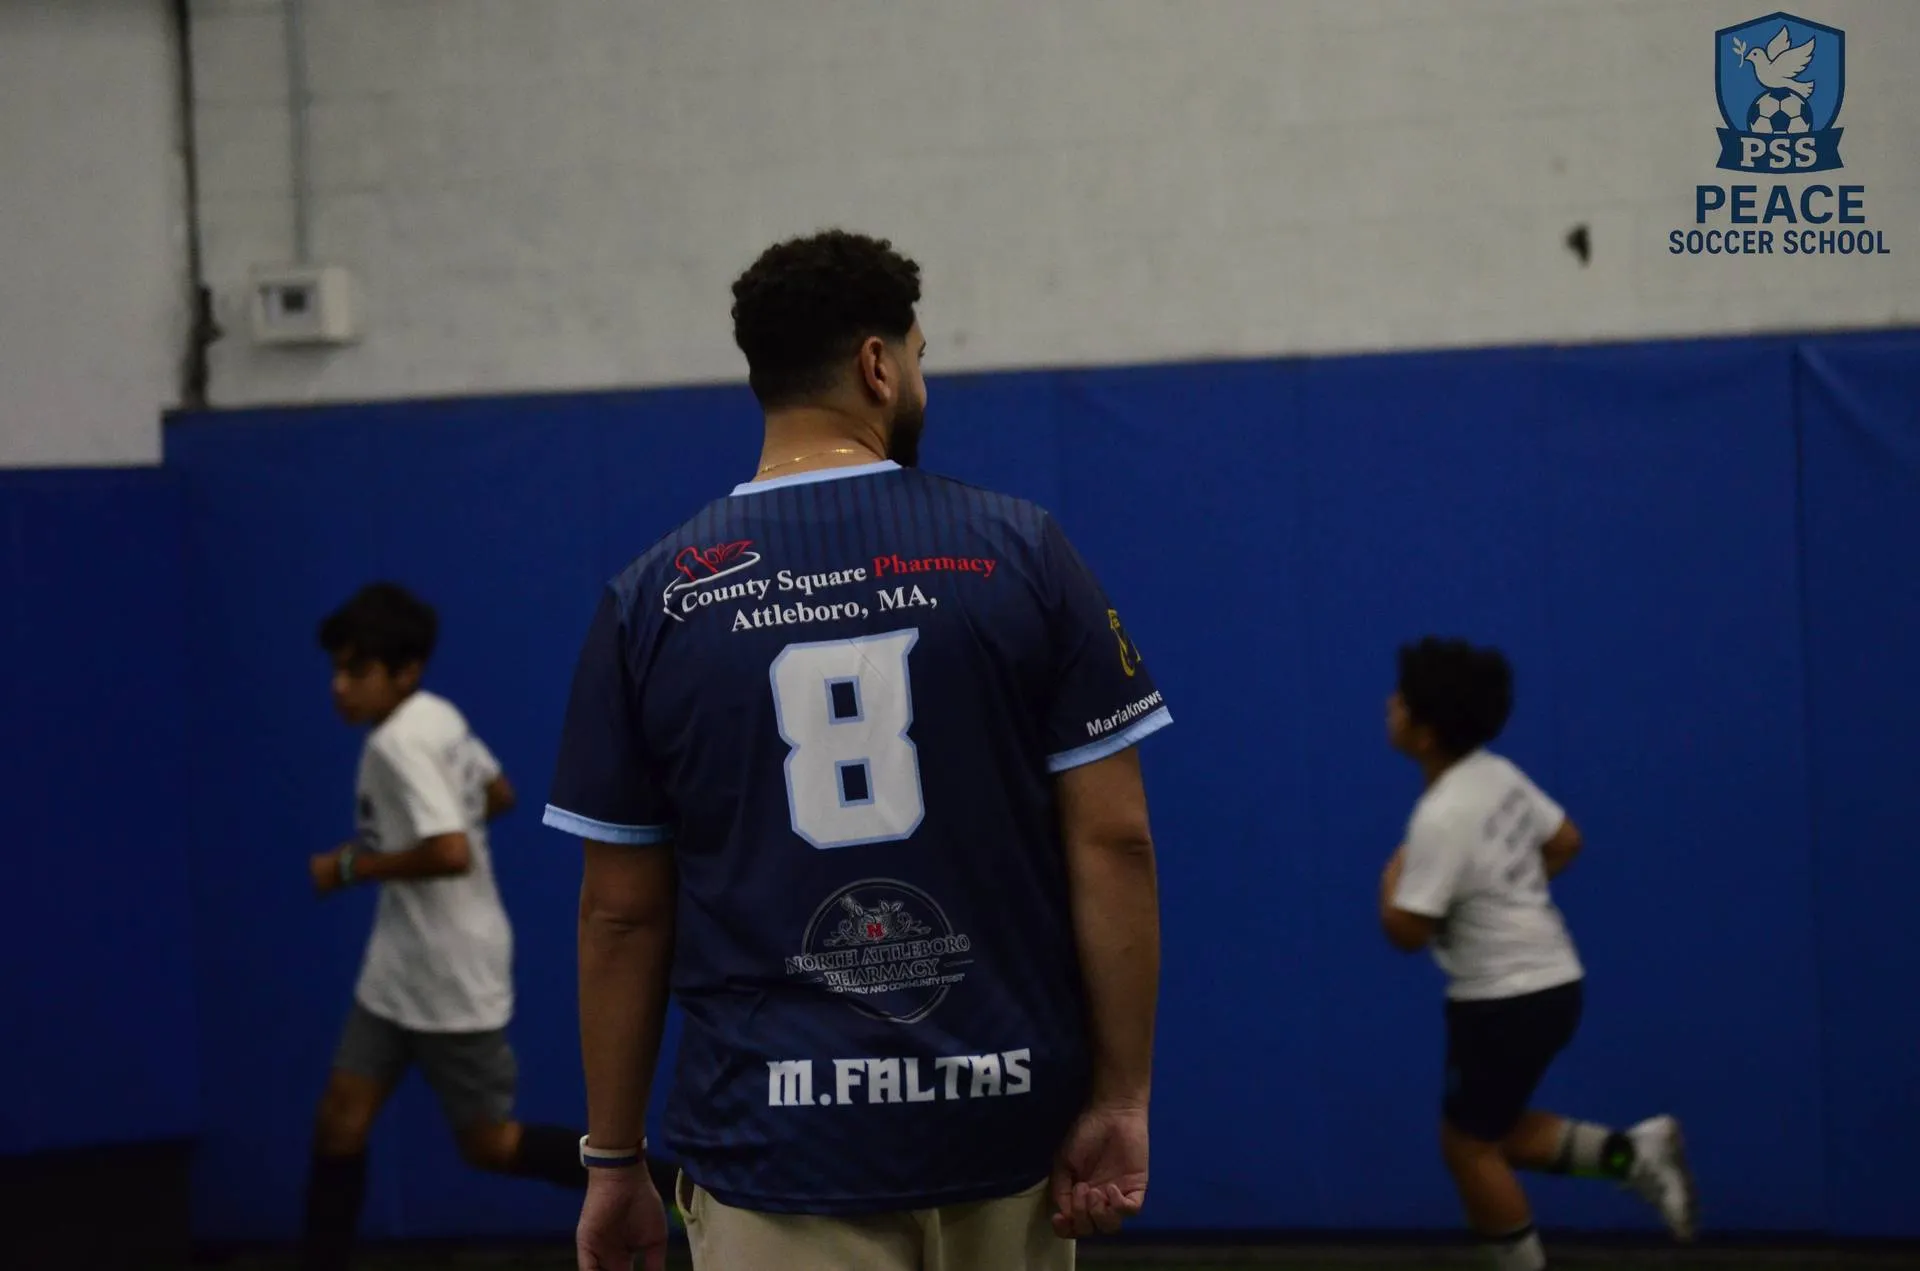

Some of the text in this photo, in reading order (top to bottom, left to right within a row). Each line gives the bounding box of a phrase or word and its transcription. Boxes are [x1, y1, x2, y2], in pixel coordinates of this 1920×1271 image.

[681, 554, 996, 613] County Square Pharmacy
[731, 584, 937, 632] Attleboro, MA,
[769, 627, 925, 850] 8
[784, 933, 971, 975] NORTH ATTLEBORO
[824, 958, 940, 986] PHARMACY
[766, 1047, 1032, 1106] M.FALTAS
